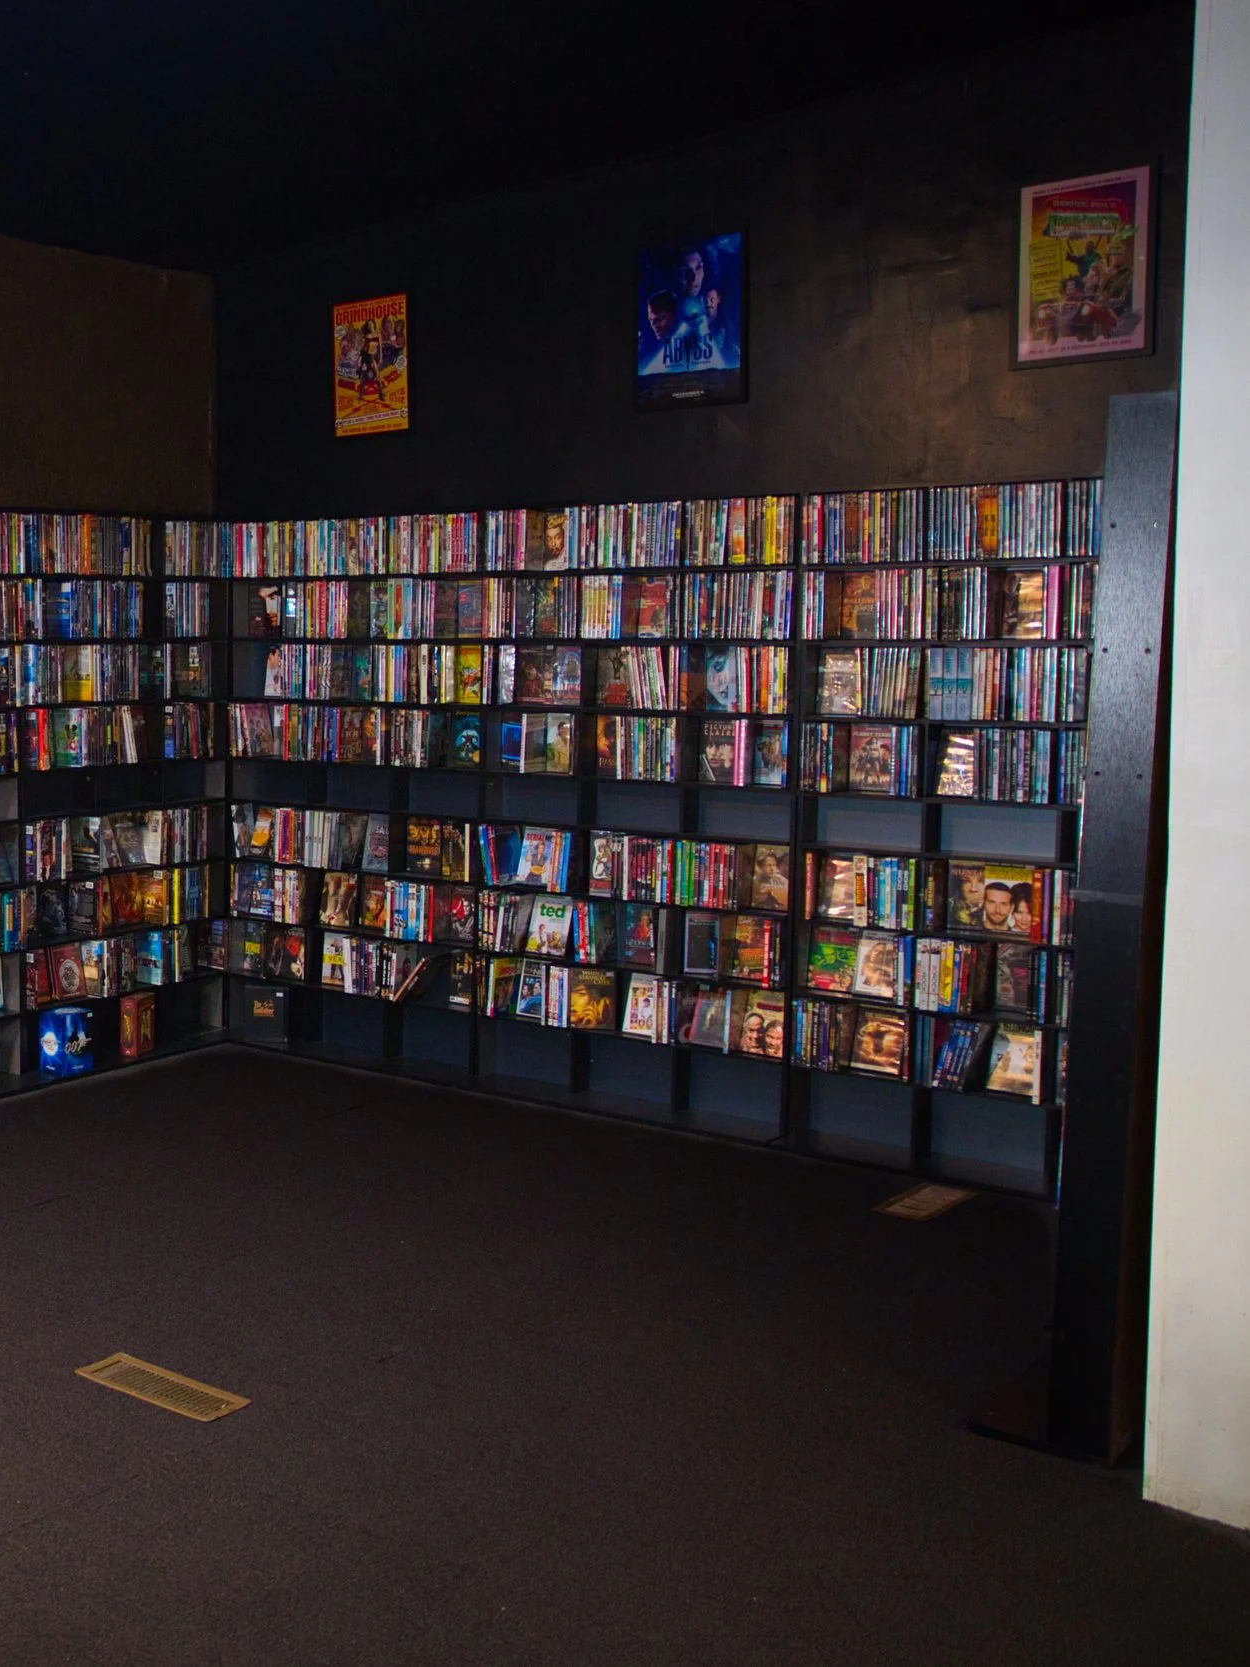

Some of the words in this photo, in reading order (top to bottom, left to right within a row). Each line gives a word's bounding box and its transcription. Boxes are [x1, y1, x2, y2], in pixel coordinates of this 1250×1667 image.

[335, 301, 405, 327] GRINDHOUSE
[662, 333, 714, 367] ABYSS
[540, 903, 566, 918] ted
[64, 1039, 84, 1055] 007
